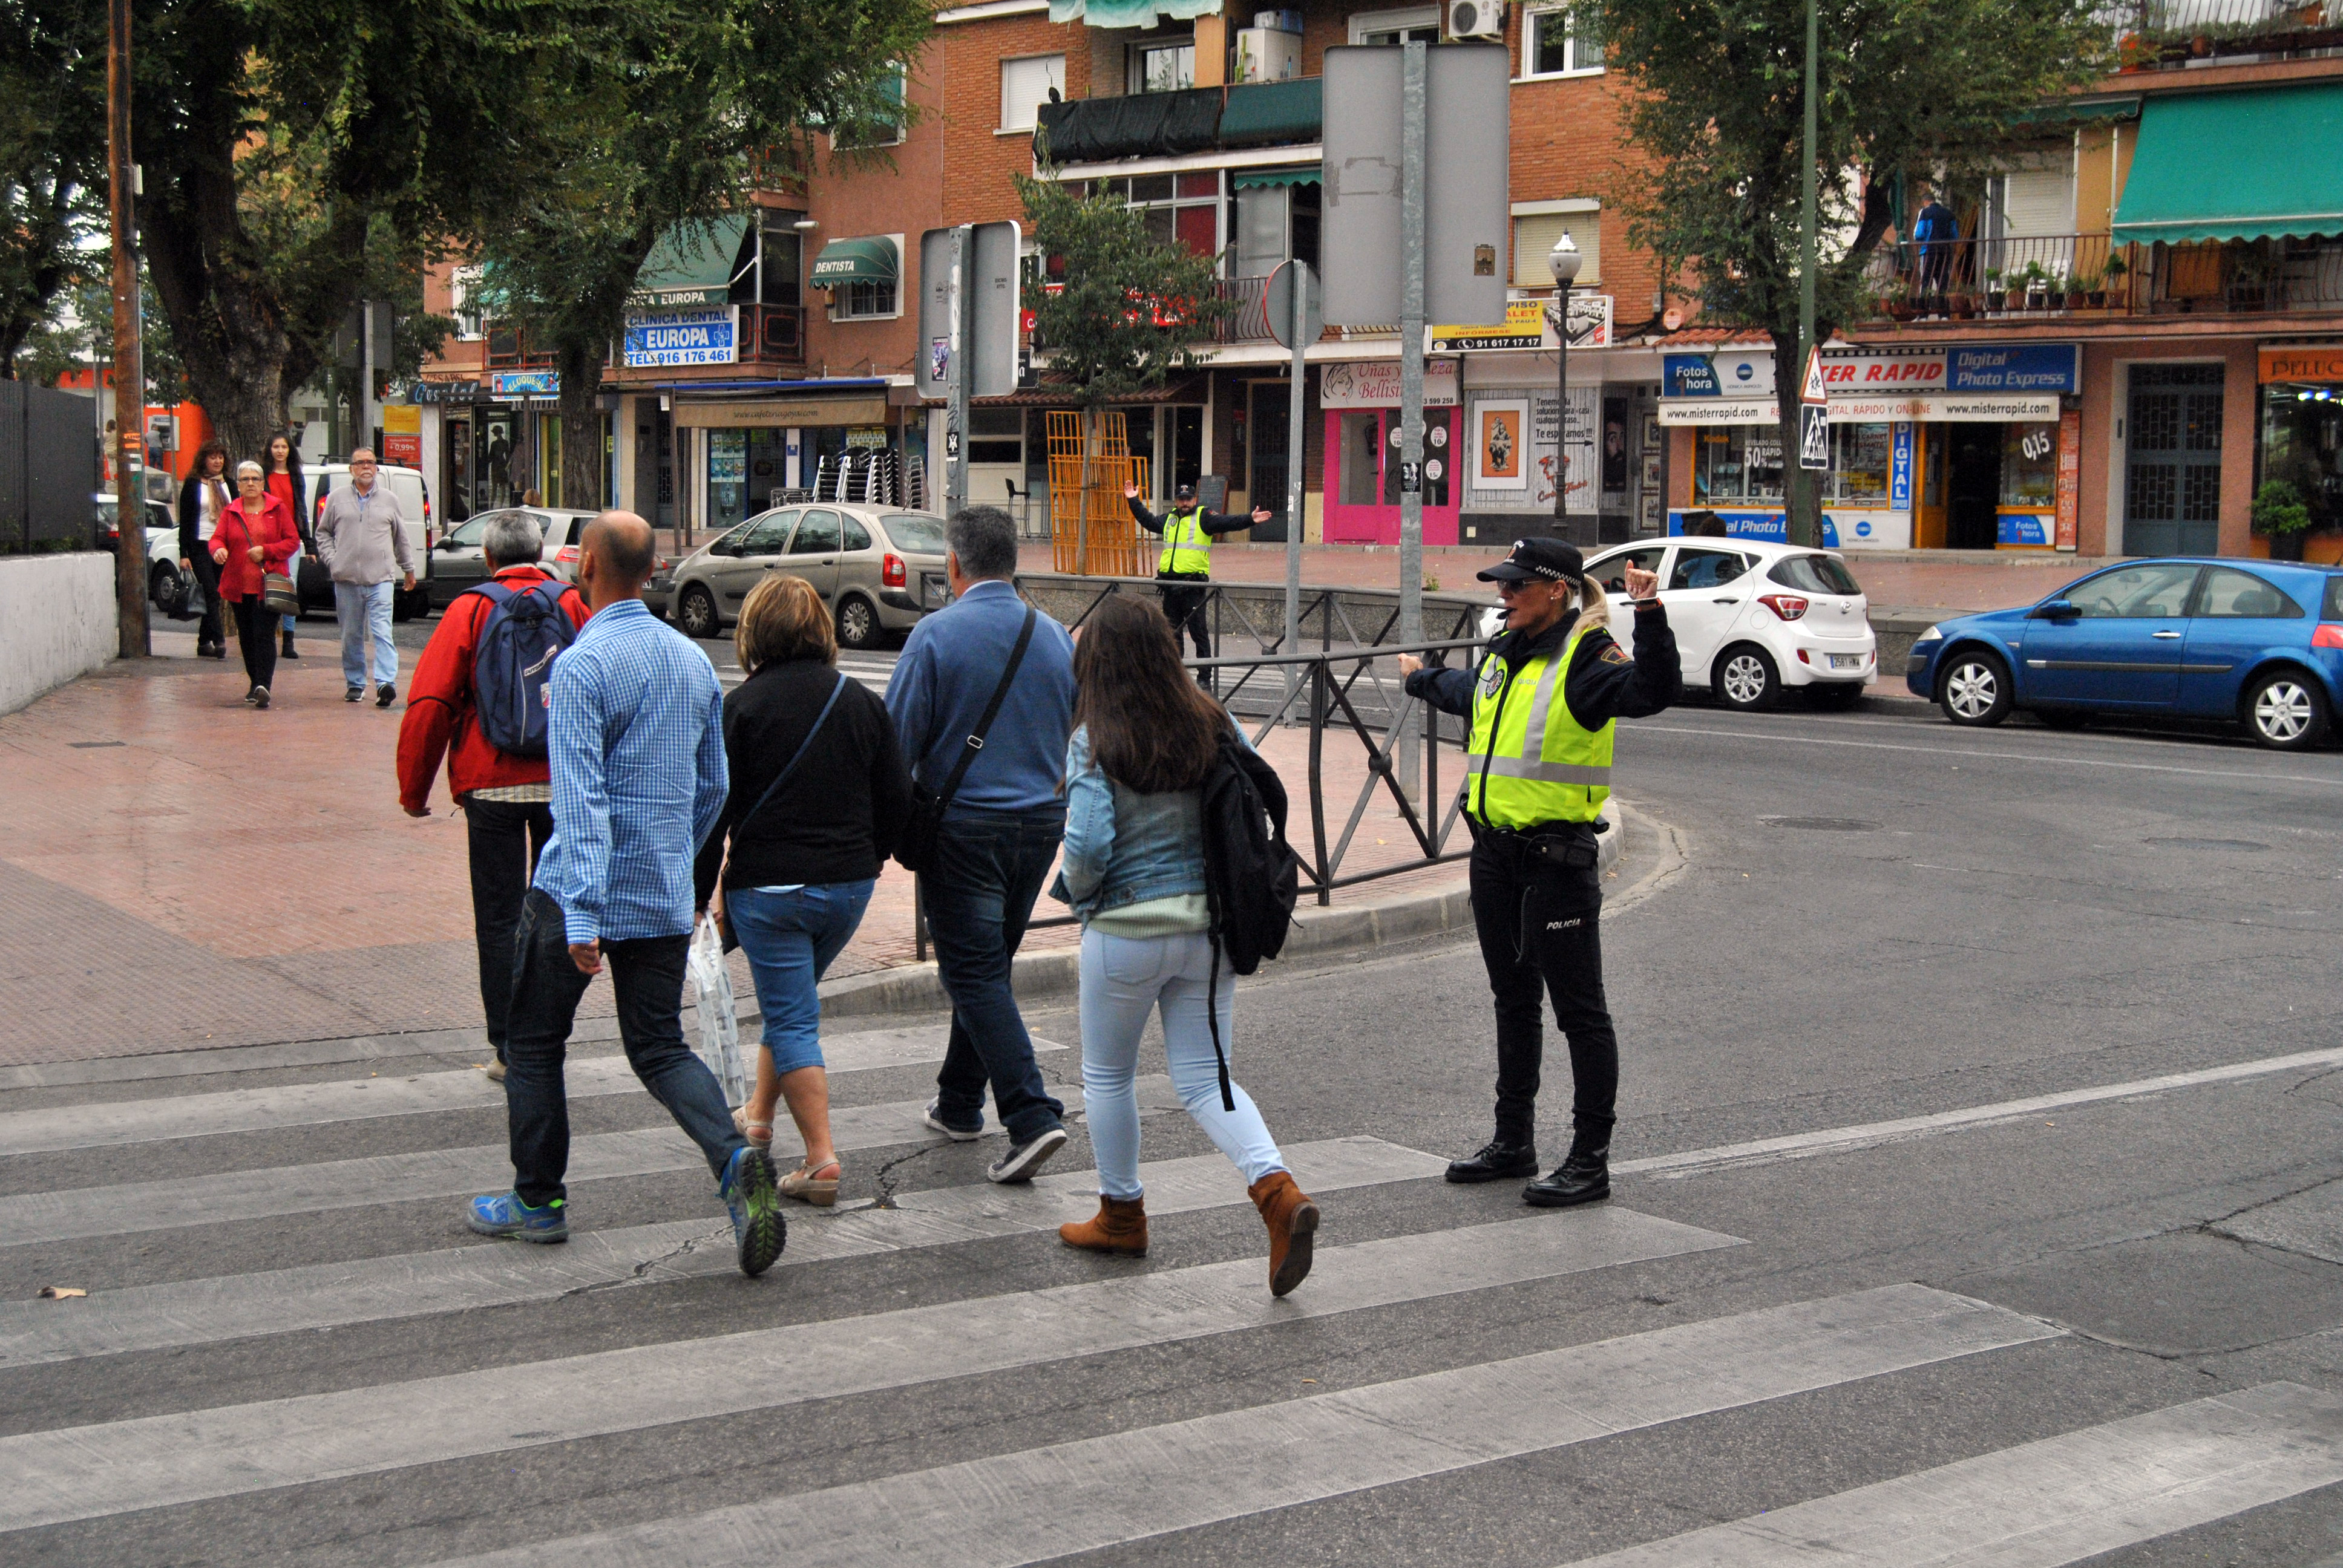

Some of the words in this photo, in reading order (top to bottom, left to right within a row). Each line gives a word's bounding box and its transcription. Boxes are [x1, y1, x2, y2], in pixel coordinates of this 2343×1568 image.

[815, 261, 854, 273] DENTISTA
[661, 292, 706, 304] EUROPA
[681, 310, 729, 323] DENTAL
[647, 327, 709, 348] EUROPA
[1476, 339, 1488, 348] 91
[1491, 339, 1509, 347] 617
[1512, 338, 1524, 347] 17
[1527, 338, 1539, 346] 17
[658, 352, 680, 364] 916
[684, 351, 706, 362] 176
[710, 349, 730, 362] 461
[1958, 352, 2007, 368] Digital
[1357, 364, 1392, 377] Uñas
[1676, 366, 1708, 377] Fotos
[1864, 362, 1944, 382] RAPID
[1686, 378, 1712, 390] hora
[1956, 371, 2002, 386] Photo
[2005, 371, 2066, 387] Express
[1359, 379, 1402, 398] Bellisi
[1667, 406, 1758, 421] www.misterrapid.com
[1853, 403, 1885, 414] RÁPIDO
[1896, 404, 1931, 414] ON-LINE
[1946, 402, 2050, 417] www.misterrapid.com
[1536, 428, 1545, 438] Te
[1546, 430, 1585, 440] espamos
[2022, 431, 2050, 461] 0,15
[1745, 446, 1761, 468] 50
[1740, 520, 1778, 533] Photo
[2016, 522, 2037, 531] Fotos
